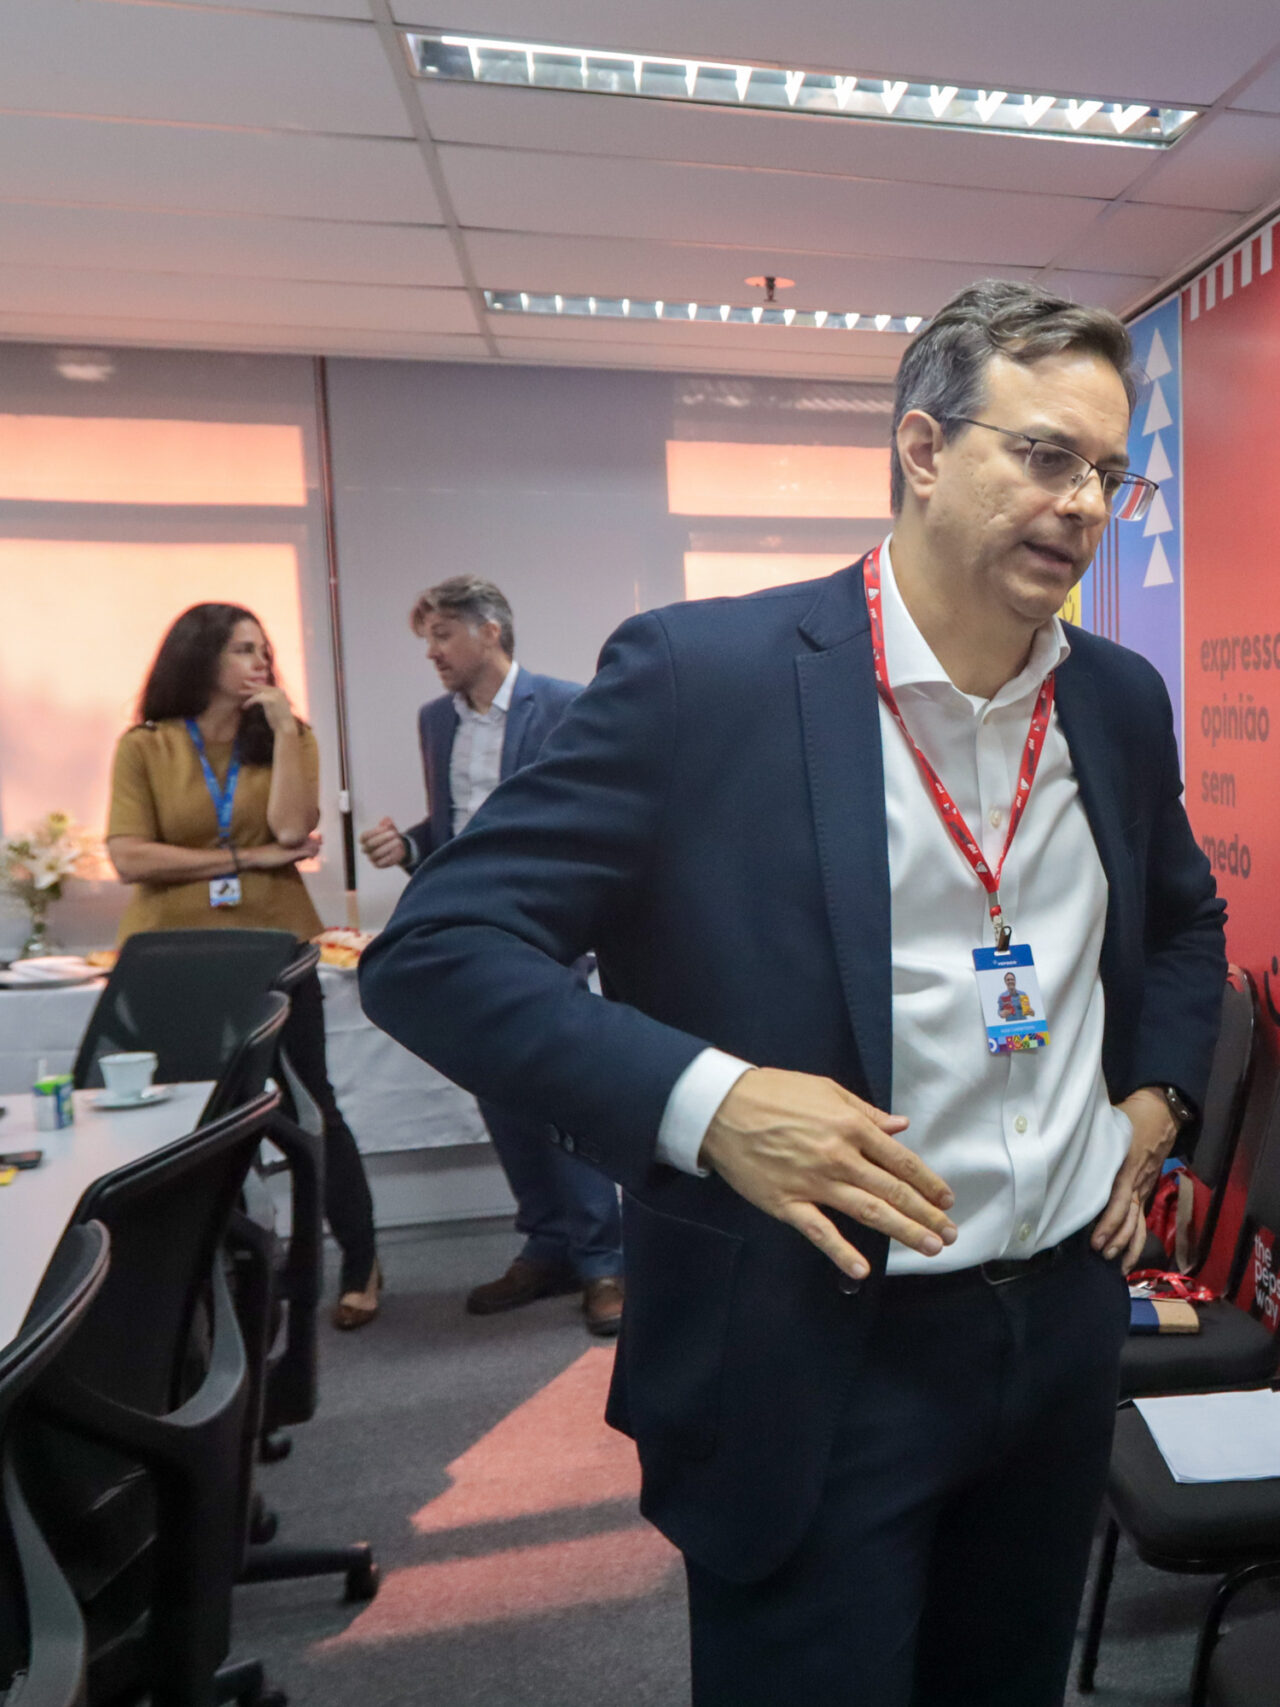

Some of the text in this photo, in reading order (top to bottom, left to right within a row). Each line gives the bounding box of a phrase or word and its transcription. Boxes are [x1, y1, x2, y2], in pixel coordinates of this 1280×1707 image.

[1201, 692, 1269, 748] opinião
[1202, 770, 1235, 808] sem
[1202, 833, 1251, 879] medo
[1254, 1233, 1272, 1269] the
[1255, 1285, 1279, 1328] way
